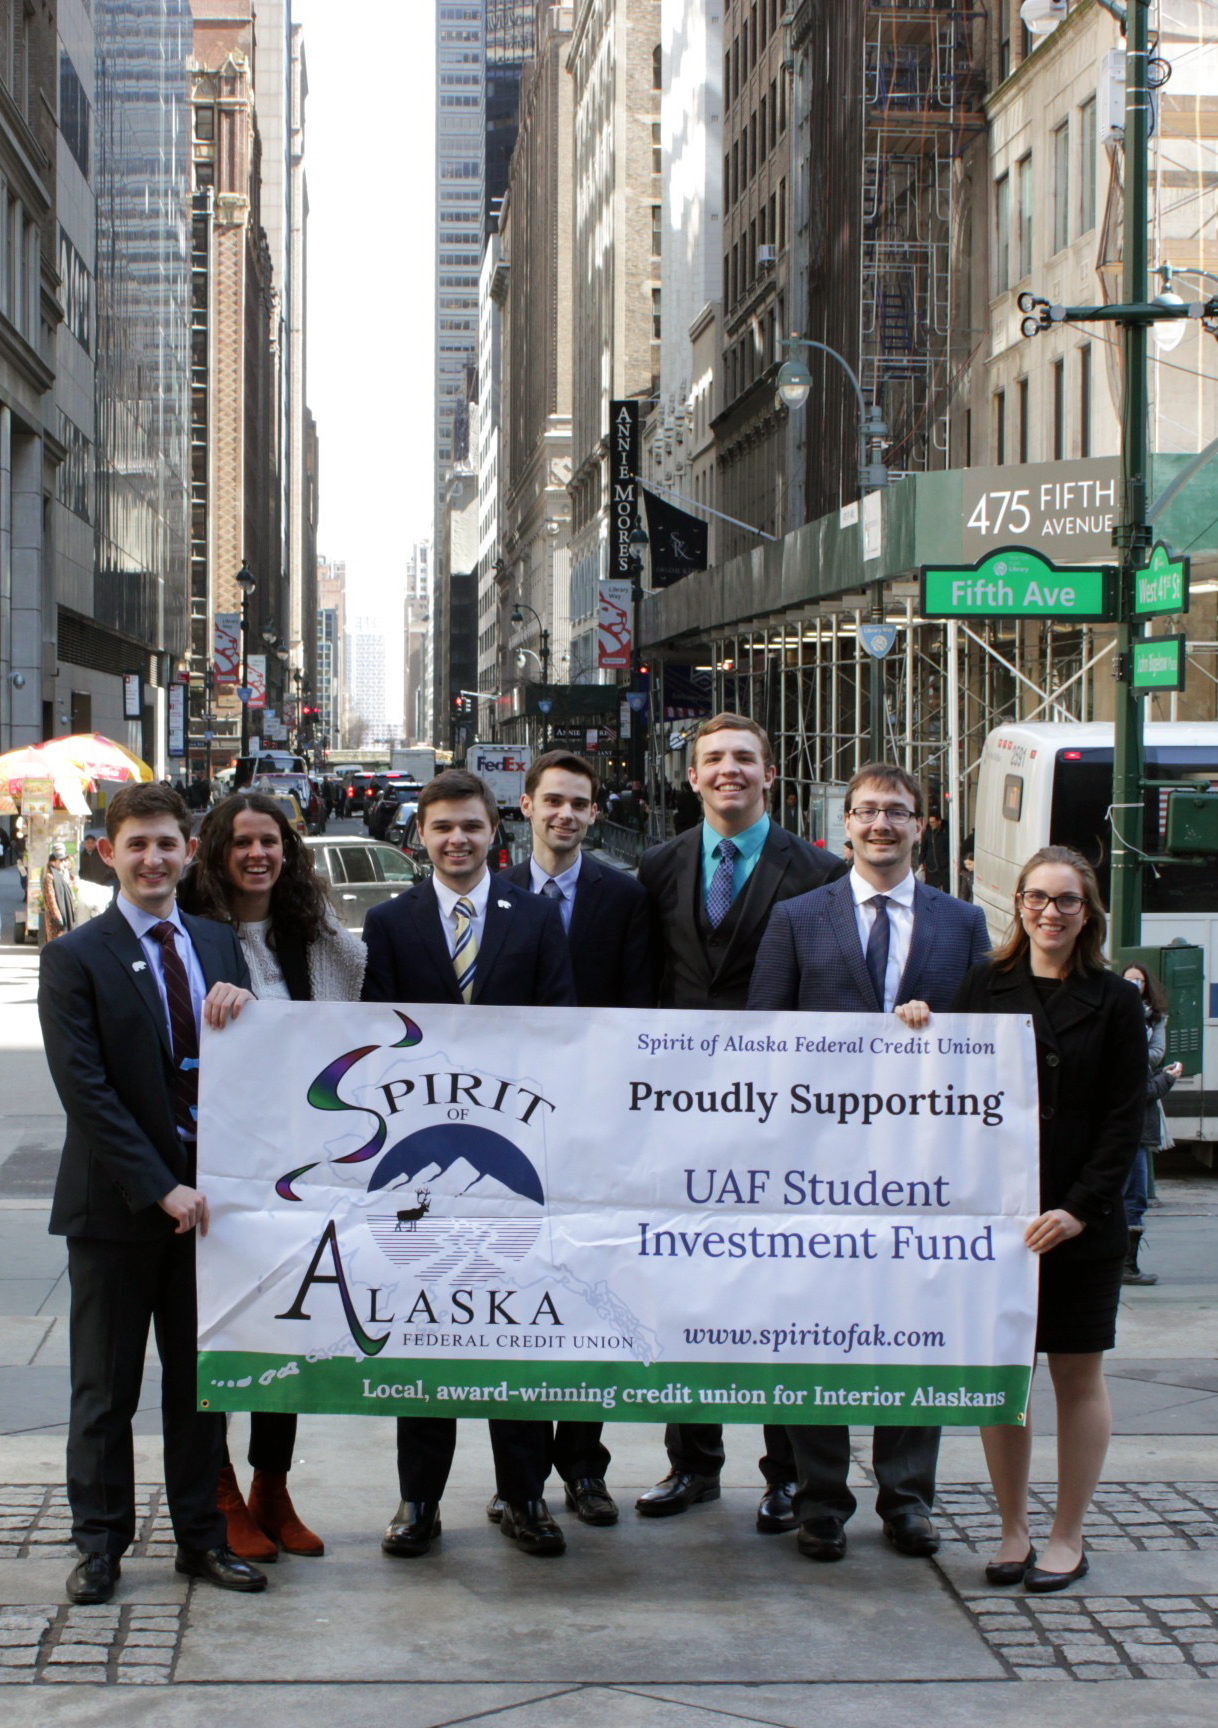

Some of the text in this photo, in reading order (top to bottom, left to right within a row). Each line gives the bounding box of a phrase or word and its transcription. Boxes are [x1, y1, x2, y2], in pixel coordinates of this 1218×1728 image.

[614, 406, 635, 571] ANNIE MOORES
[966, 479, 1115, 536] 475 FIFTH
[1041, 514, 1115, 537] AVENUE
[951, 579, 1076, 607] Fifth Ave
[1138, 577, 1158, 604] West
[1172, 573, 1181, 599] St
[477, 756, 526, 772] FedEx
[638, 1033, 996, 1056] Spirit of Alaska Federal Credit Union
[446, 1108, 470, 1121] OF
[628, 1081, 1005, 1126] Proudly Supporting
[684, 1168, 951, 1208] UAF Student
[637, 1223, 996, 1262] Investment Fund
[402, 1333, 634, 1350] FEDERAL CREDIT UNION
[683, 1322, 946, 1353] www.spiritofak.com
[362, 1379, 1006, 1409] Local, award-winning credit union for Interior Alaskans
